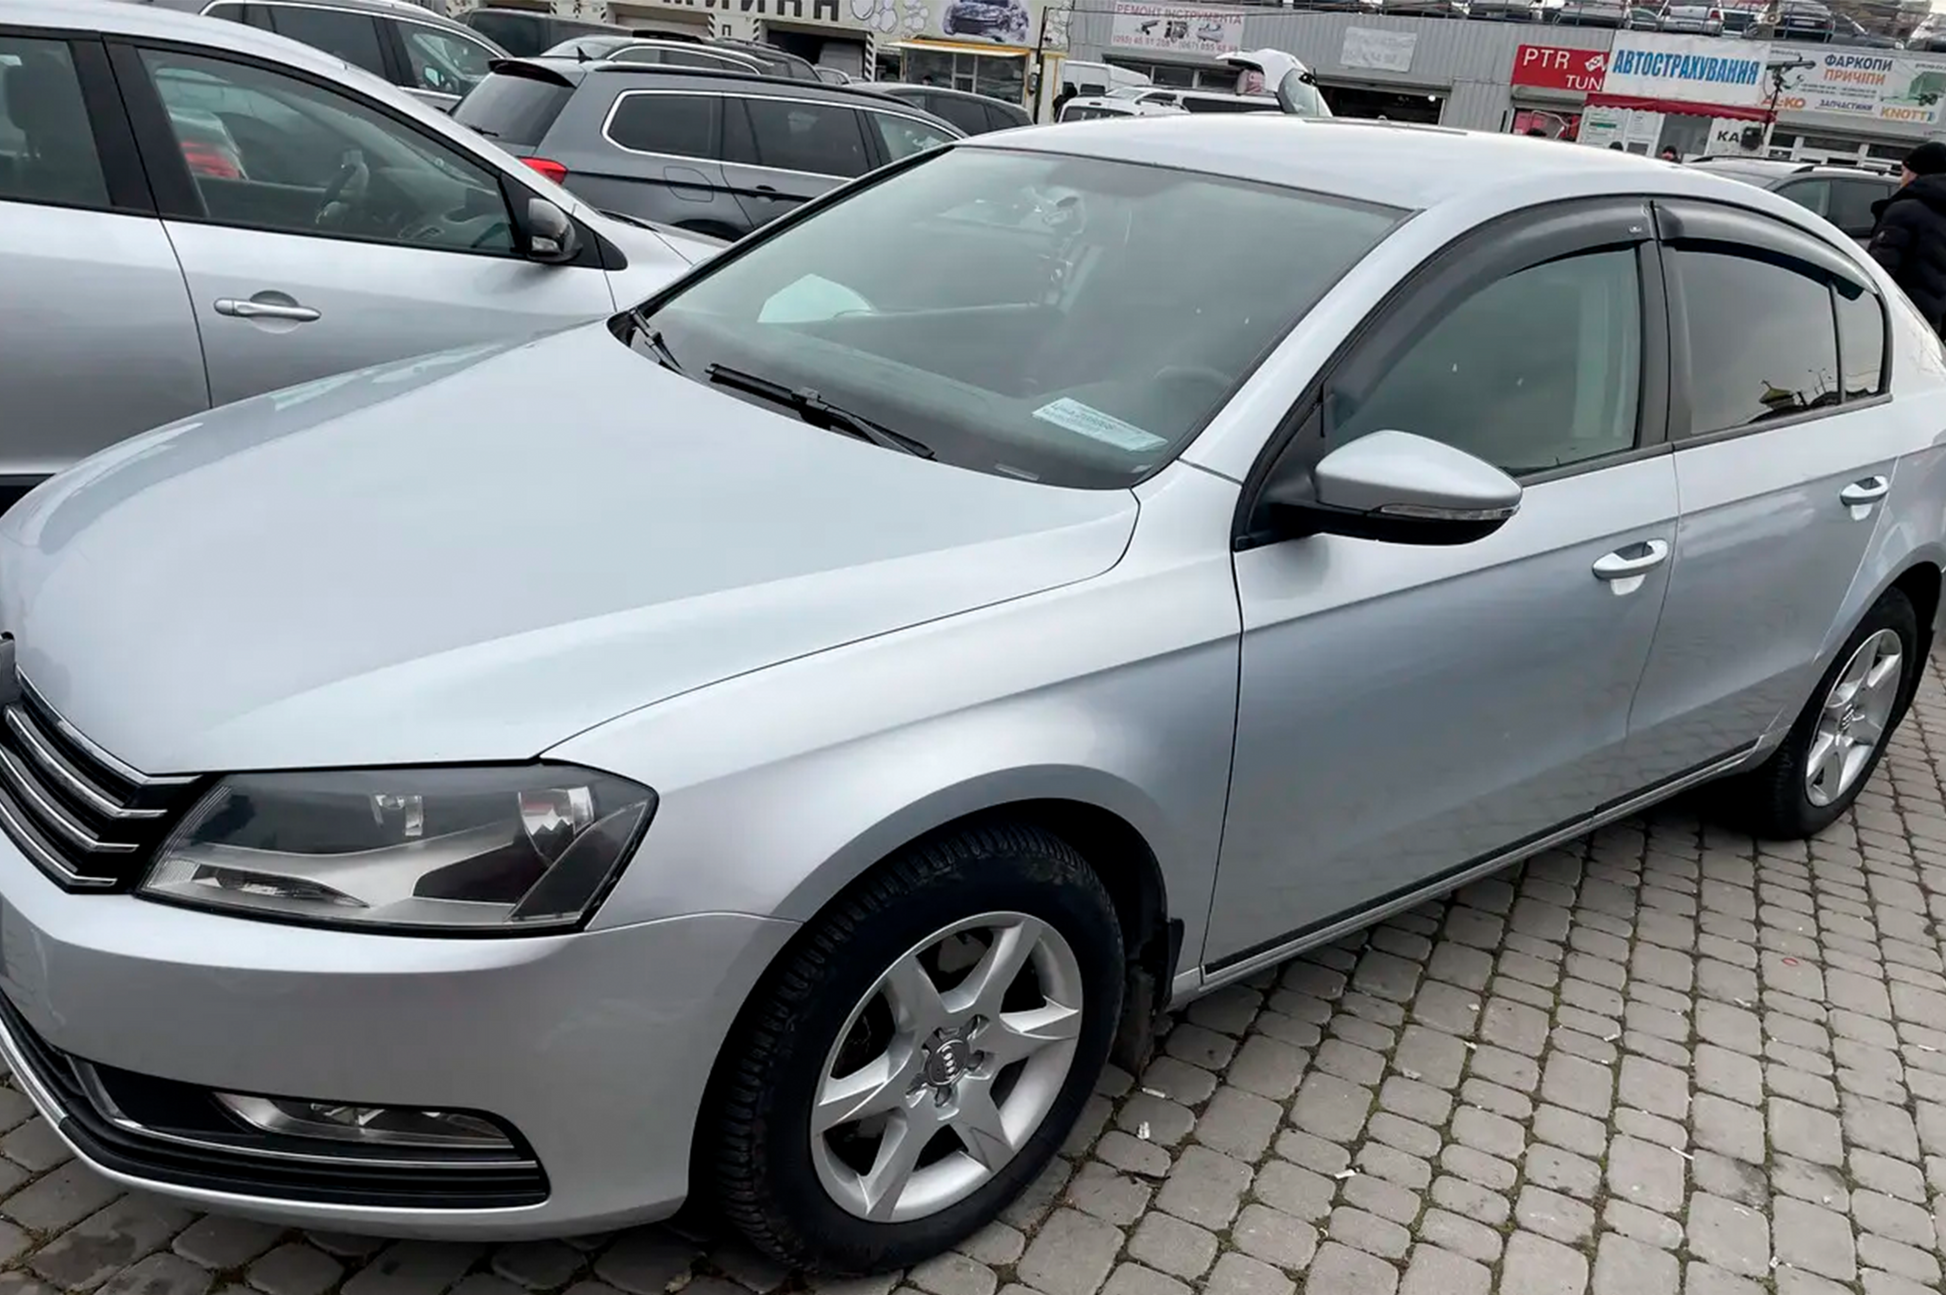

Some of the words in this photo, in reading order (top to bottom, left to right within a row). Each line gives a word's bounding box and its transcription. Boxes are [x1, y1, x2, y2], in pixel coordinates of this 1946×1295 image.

[1522, 47, 1570, 69] PTR
[1612, 49, 1761, 86] АВТОСТРАХУВАННЯ
[1824, 53, 1893, 72] ФАРКОПИ
[1823, 68, 1886, 86] ПРИЧІПИ
